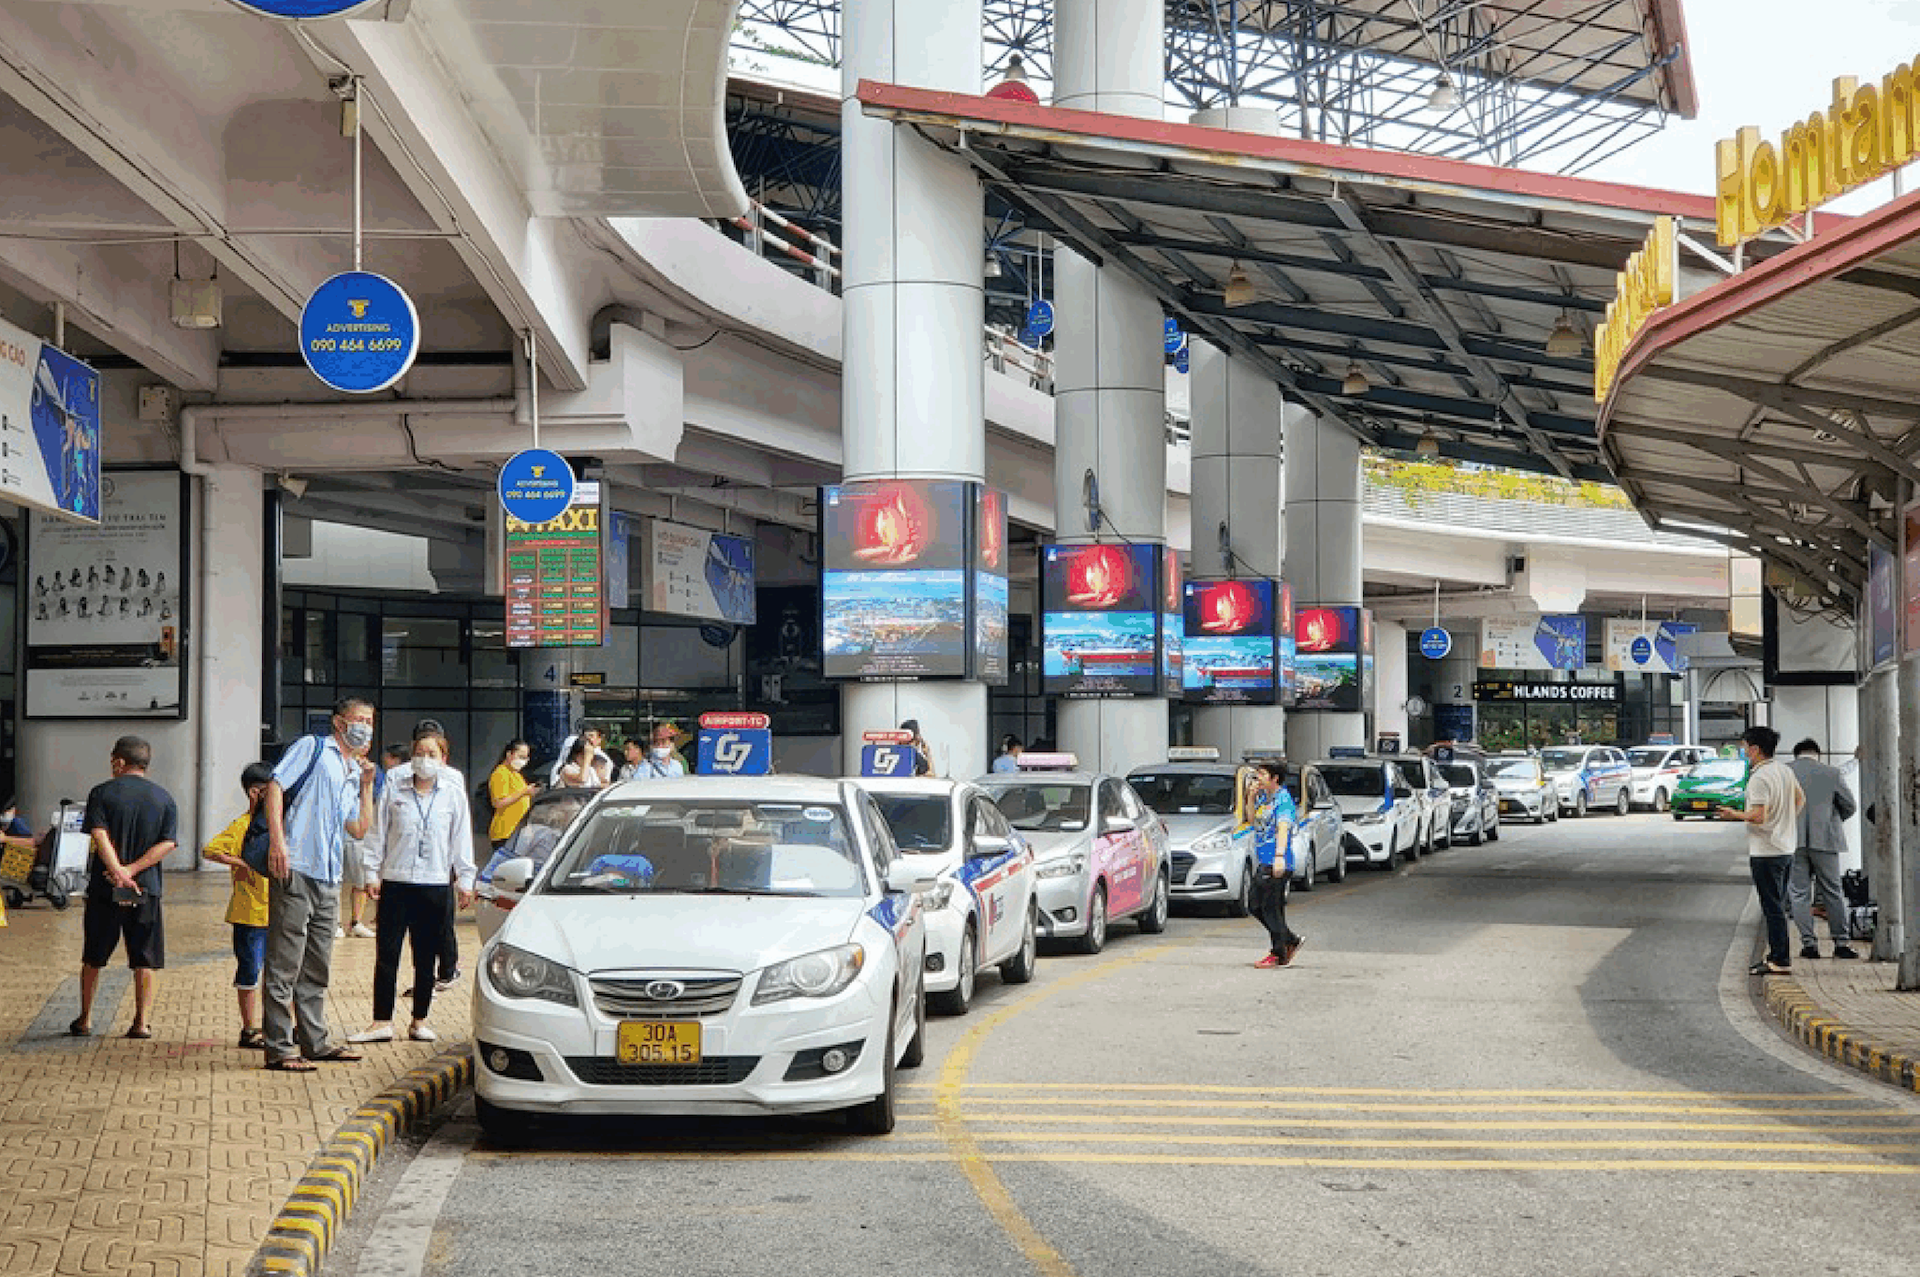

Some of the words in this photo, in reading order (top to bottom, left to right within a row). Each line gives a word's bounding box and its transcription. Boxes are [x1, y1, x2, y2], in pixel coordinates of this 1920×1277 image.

[326, 323, 391, 333] ADVERTISING
[311, 338, 336, 352] 090
[339, 338, 364, 352] 464
[368, 338, 401, 352] 6699
[544, 664, 555, 682] 4
[1453, 685, 1463, 698] 2
[1570, 685, 1615, 699] COFFEE
[642, 1024, 677, 1042] 30A
[629, 1043, 692, 1062] 305.15
